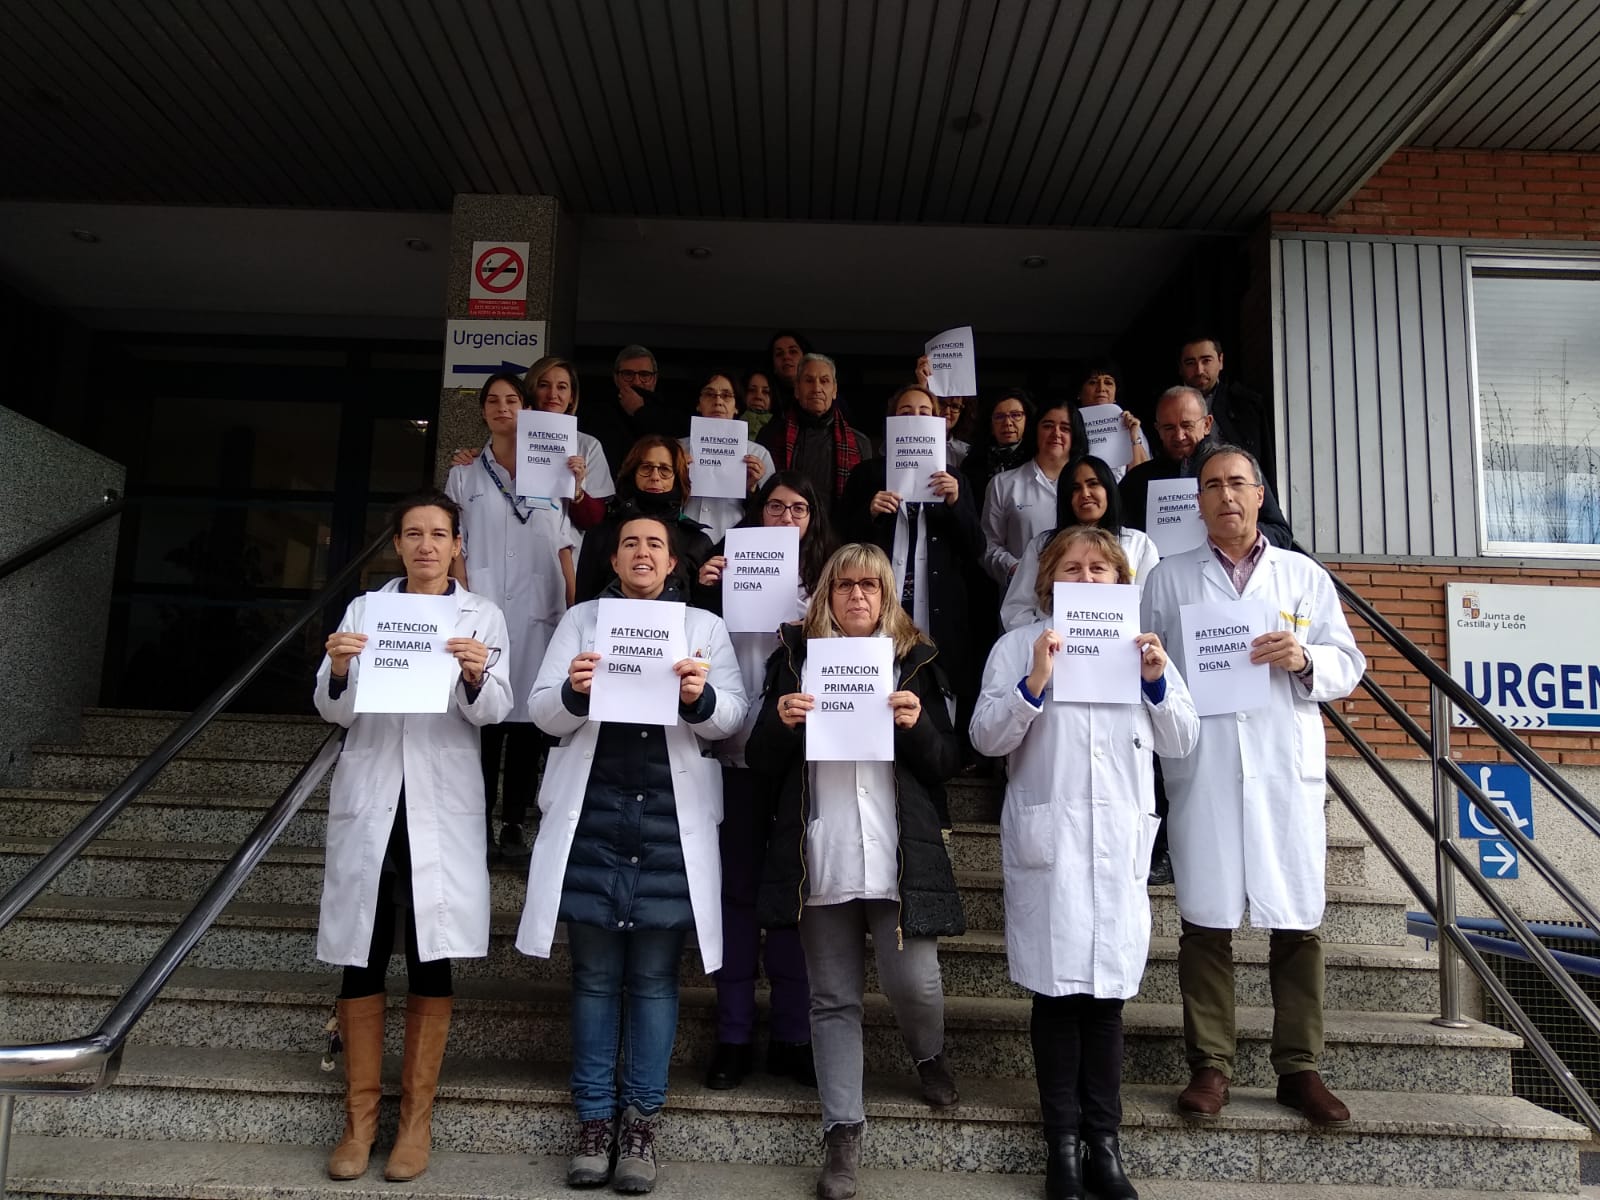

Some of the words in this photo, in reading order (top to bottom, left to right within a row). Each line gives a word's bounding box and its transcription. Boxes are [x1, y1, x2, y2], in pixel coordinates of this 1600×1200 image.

[454, 330, 538, 349] Urgencias
[1087, 426, 1118, 435] PRIMARIA
[528, 431, 568, 441] #ATENCION
[701, 436, 738, 445] #ATENCION
[896, 436, 935, 444] #ATENCION
[529, 444, 566, 453] PRIMARIA
[701, 448, 735, 456] PRIMARIA
[897, 448, 933, 456] PRIMARIA
[528, 456, 551, 465] DIGNA
[699, 458, 721, 466] DIGNA
[895, 461, 918, 469] DIGNA
[1159, 504, 1196, 512] PRIMARIA
[1157, 516, 1181, 525] DIGNA
[734, 551, 784, 560] #ATENCION
[736, 566, 780, 575] PRIMARIA
[733, 581, 762, 590] DIGNA
[1066, 611, 1123, 622] #ATENCION
[1482, 612, 1510, 620] Junta
[1513, 613, 1526, 621] de
[377, 622, 438, 634] #ATENCION
[1456, 620, 1490, 628] Castilla
[1493, 622, 1499, 630] y
[1502, 621, 1526, 629] León
[610, 627, 669, 640] #ATENCION
[1069, 627, 1120, 639] PRIMARIA
[1195, 625, 1249, 640] #ATENCION
[378, 640, 432, 652] PRIMARIA
[1067, 645, 1099, 656] DIGNA
[1199, 641, 1247, 656] PRIMARIA
[612, 645, 663, 658] PRIMARIA
[374, 657, 409, 669] DIGNA
[608, 662, 641, 674] DIGNA
[1199, 660, 1231, 672] DIGNA
[821, 666, 879, 676] #ATENCION
[824, 684, 875, 694] PRIMARIA
[821, 701, 854, 712] DIGNA
